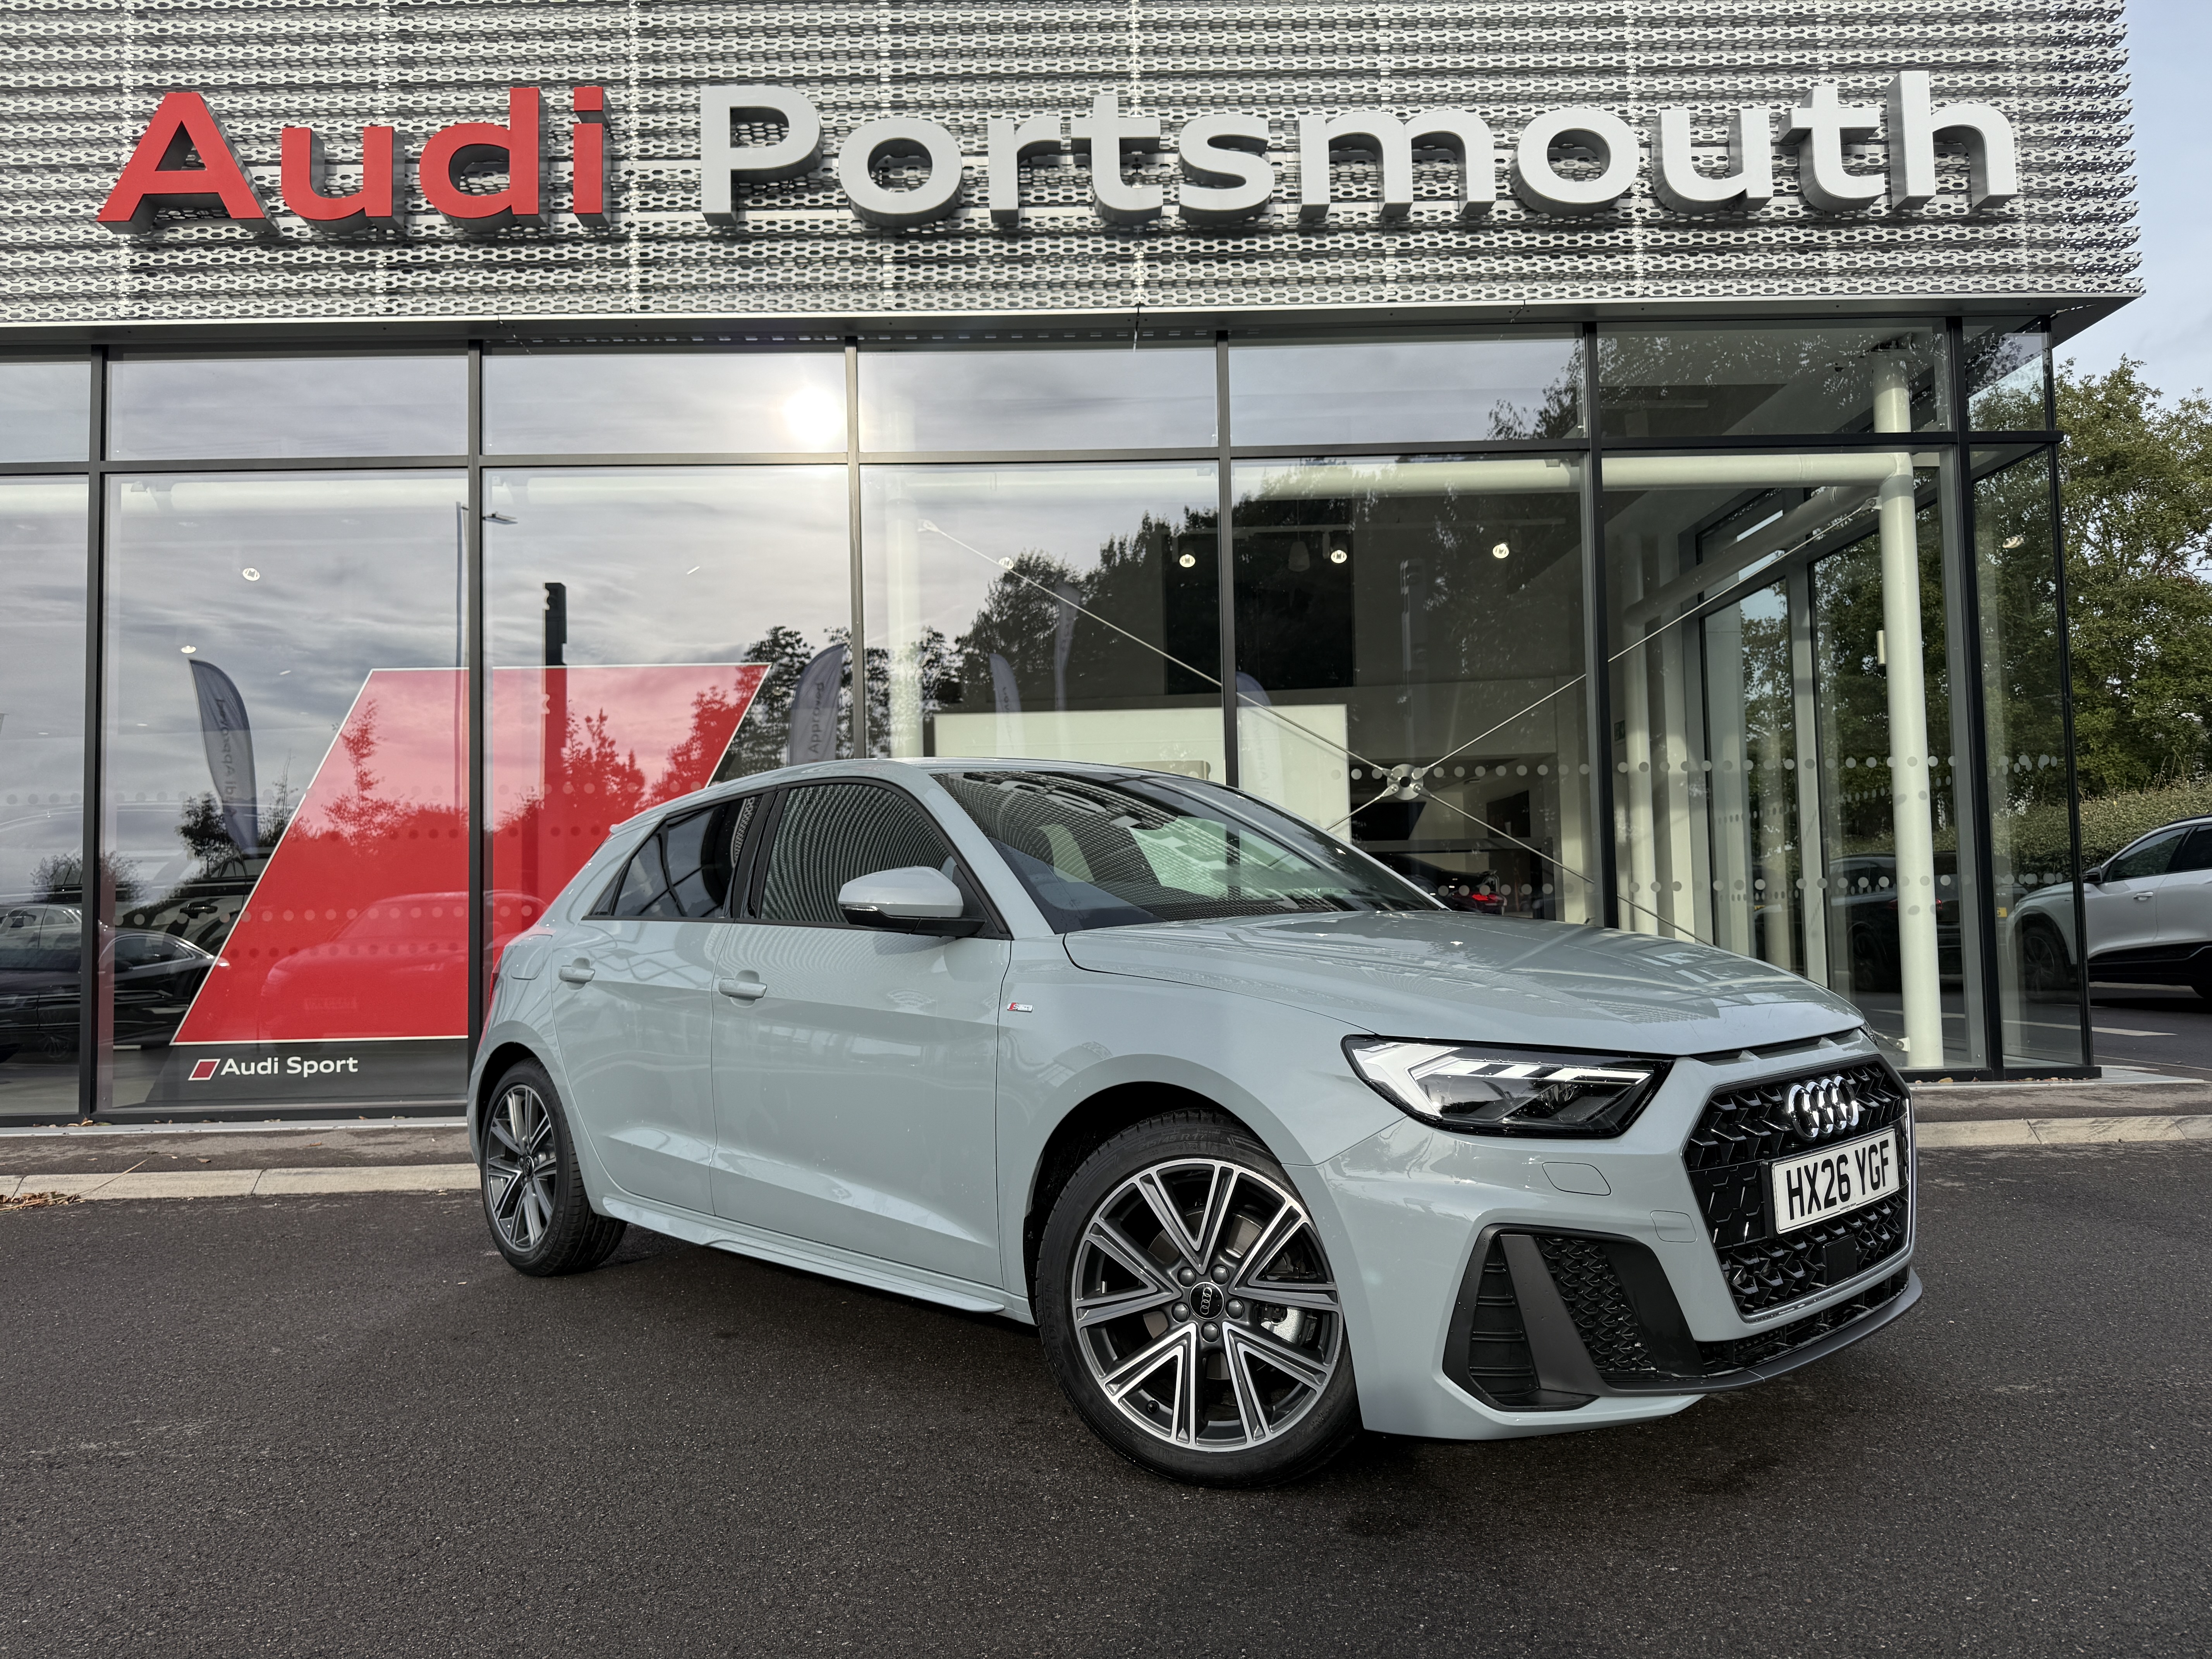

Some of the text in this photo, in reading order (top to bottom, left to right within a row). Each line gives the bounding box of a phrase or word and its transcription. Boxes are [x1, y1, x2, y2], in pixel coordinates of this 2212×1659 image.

[96, 70, 2018, 223] Audi Portsmouth
[808, 682, 824, 754] Approved
[220, 1056, 359, 1078] Audi Sport
[1786, 1139, 1889, 1220] HX26 YGF
